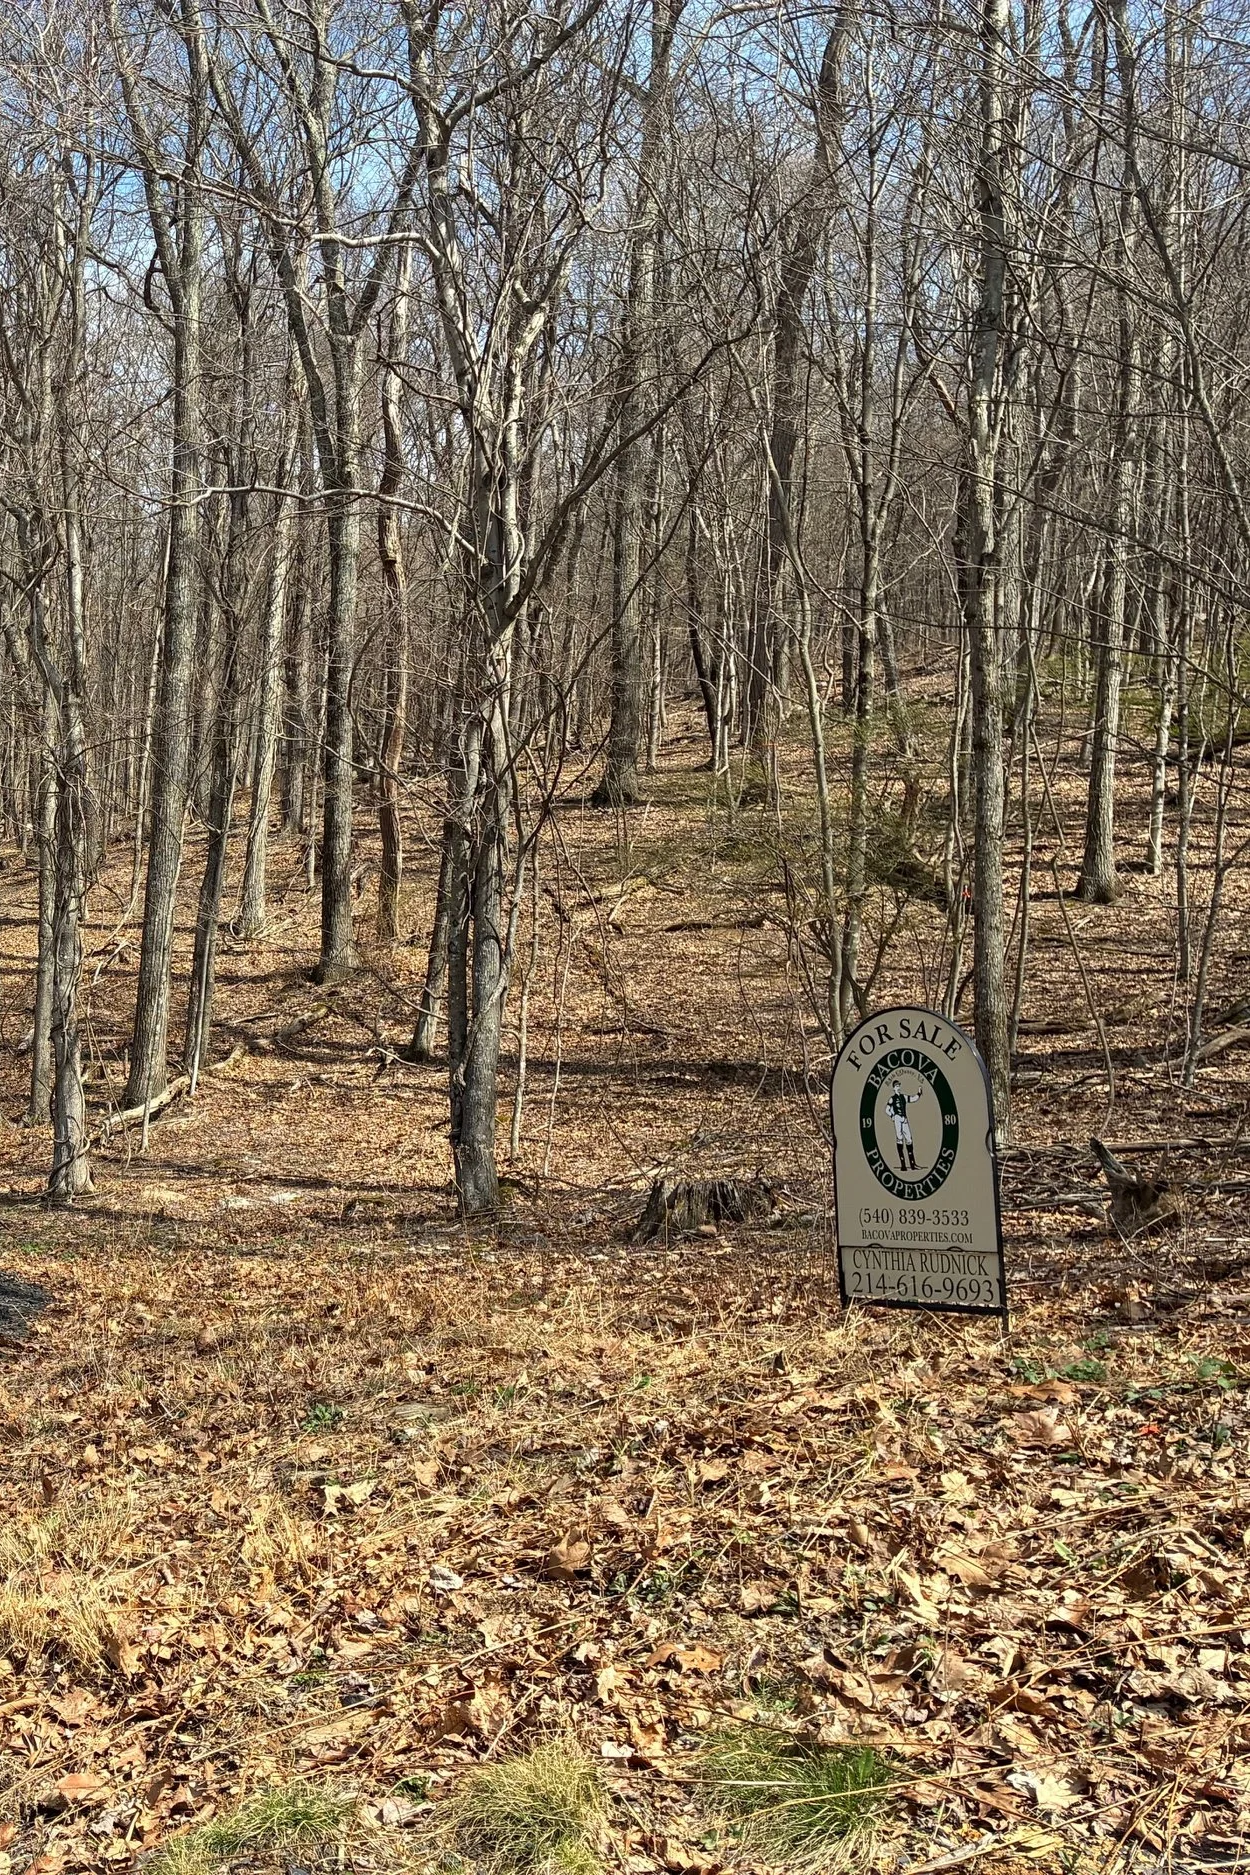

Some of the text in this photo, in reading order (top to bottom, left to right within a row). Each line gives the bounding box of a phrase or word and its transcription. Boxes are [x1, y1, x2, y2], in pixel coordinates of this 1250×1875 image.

[846, 1018, 962, 1071] FOR SALE
[868, 1049, 939, 1091] BACOVA
[862, 1114, 957, 1128] 19 80
[866, 1147, 955, 1199] PROPERTIES
[859, 1207, 969, 1228] (540) 839-3533
[861, 1229, 973, 1244] BACOVAPROPERTIES.COM
[853, 1250, 989, 1276] CYNTHIA RUDNICK
[852, 1271, 994, 1303] 214-616-9693
